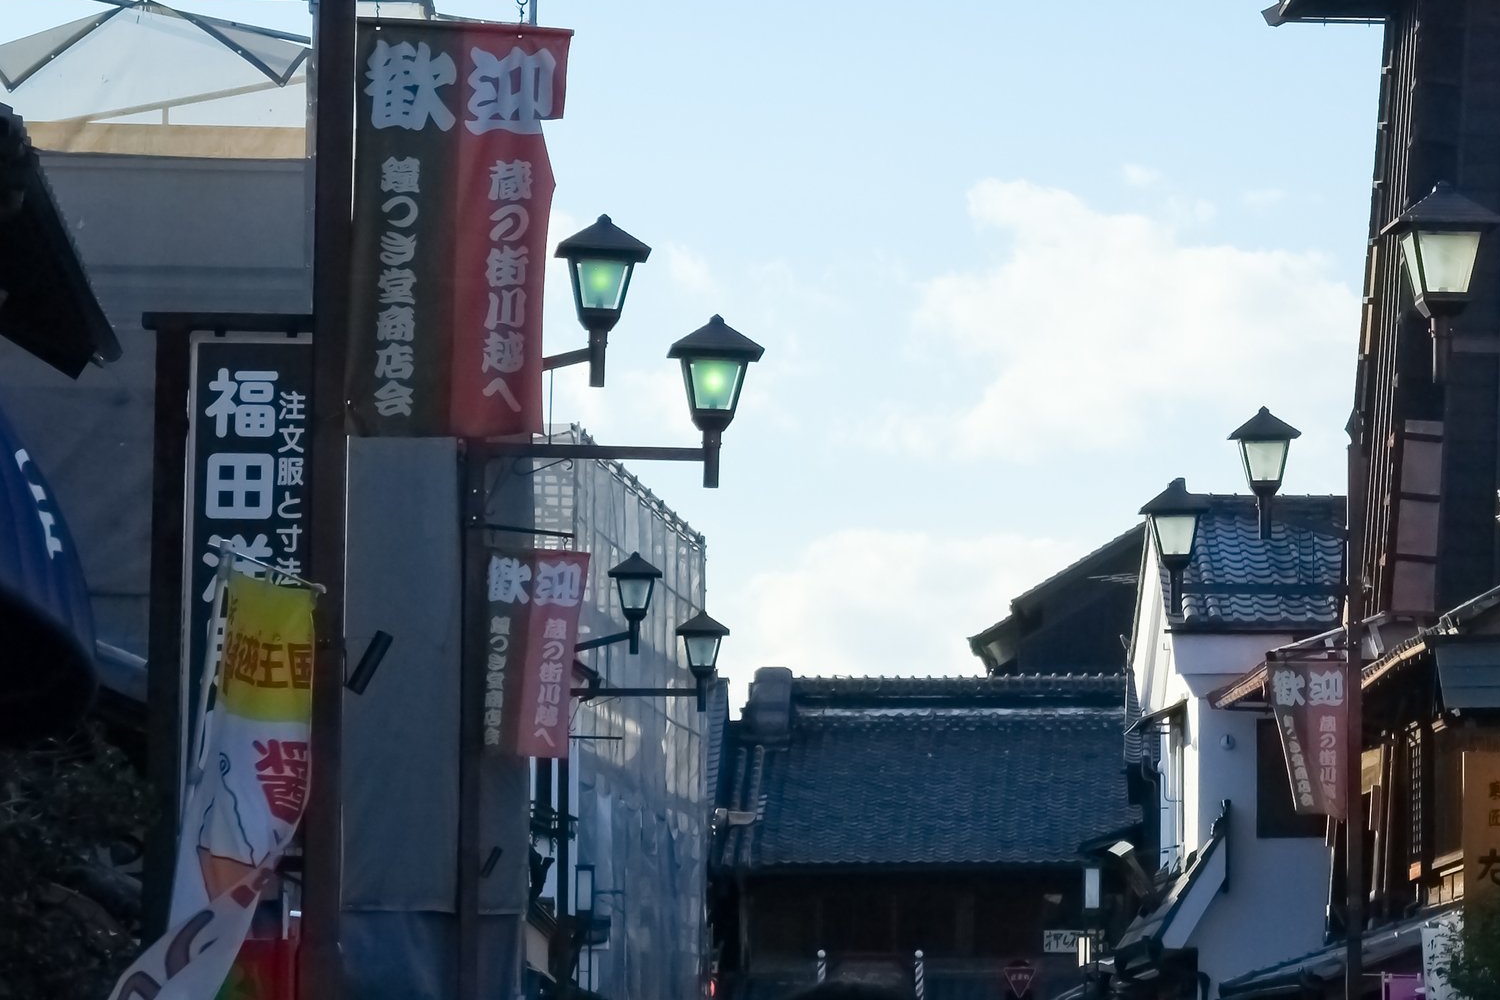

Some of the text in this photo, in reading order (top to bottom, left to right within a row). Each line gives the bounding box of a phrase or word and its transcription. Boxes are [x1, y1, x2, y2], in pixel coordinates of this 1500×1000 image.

[364, 39, 557, 136] 歓迎
[374, 156, 421, 417] 鐘つき堂商店会
[482, 159, 533, 413] 蔵の街川越へ
[487, 555, 582, 608] 歓迎
[1272, 670, 1344, 707] 歓迎
